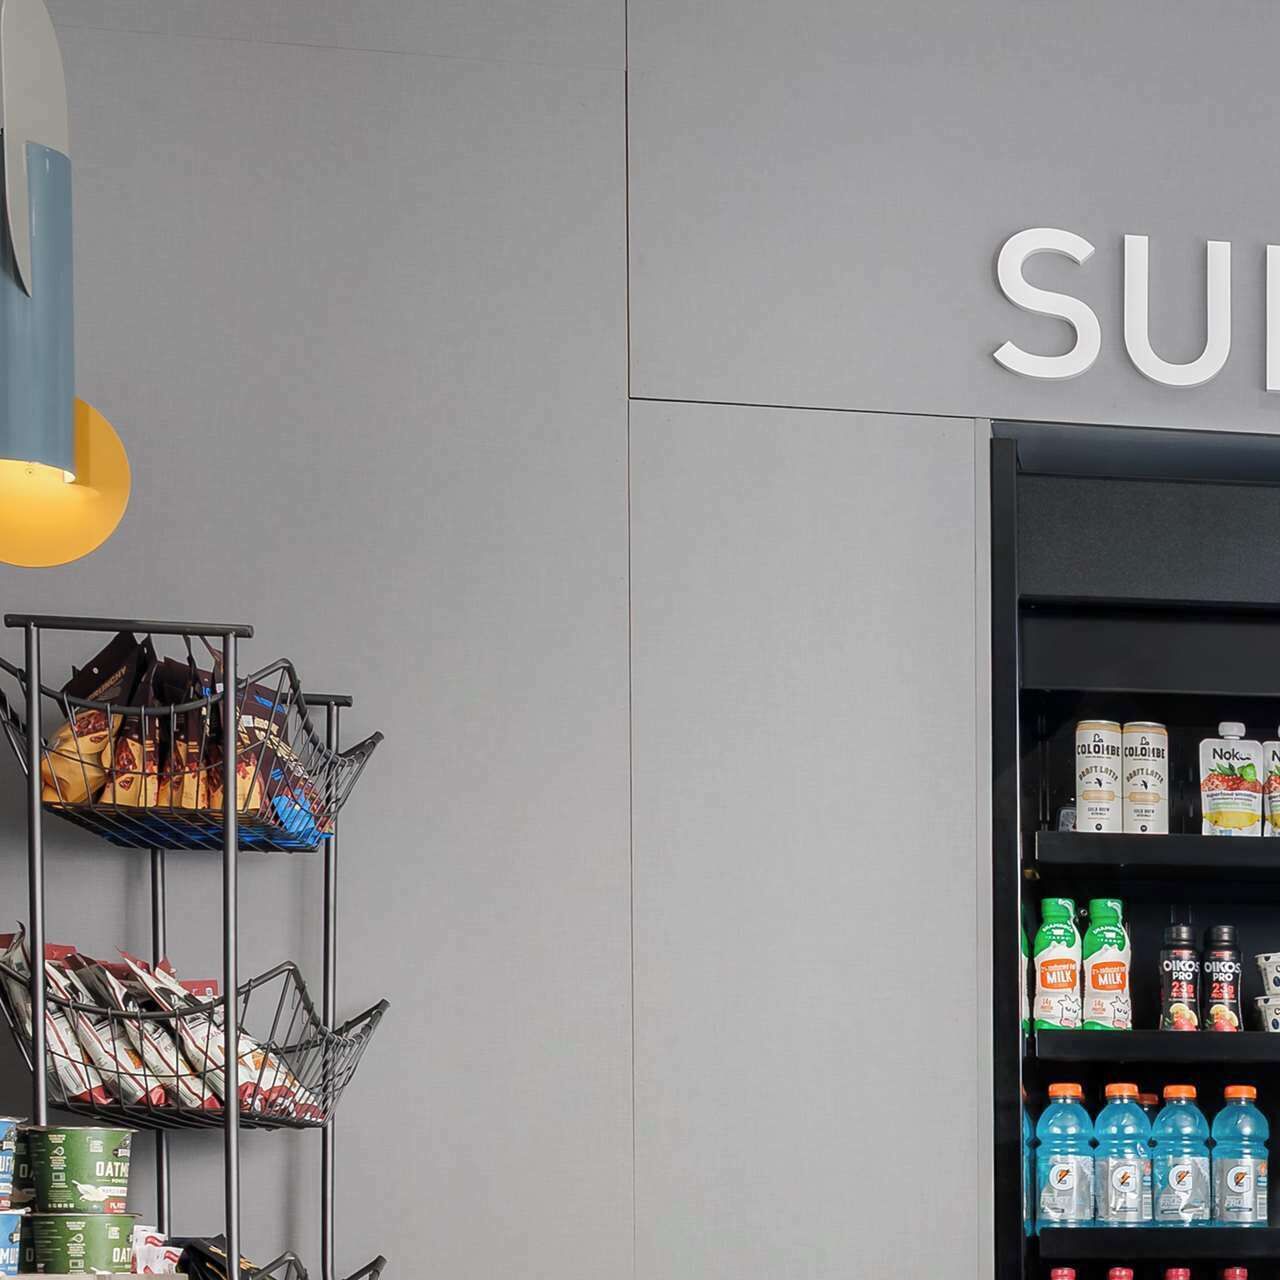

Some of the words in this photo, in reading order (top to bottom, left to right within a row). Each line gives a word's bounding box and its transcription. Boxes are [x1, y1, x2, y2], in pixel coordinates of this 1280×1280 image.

[1077, 744, 1120, 757] COLOMBE
[1124, 747, 1165, 758] COLOMBE
[1163, 960, 1200, 971] OIKOS
[1204, 961, 1240, 973] OIKOS
[1046, 971, 1072, 984] MILK
[1098, 973, 1122, 985] MILK
[1172, 972, 1193, 981] PRO
[1212, 973, 1233, 982] PRO
[1171, 982, 1194, 993] 23g
[1212, 983, 1234, 995] 23g
[96, 1161, 129, 1177] OATM
